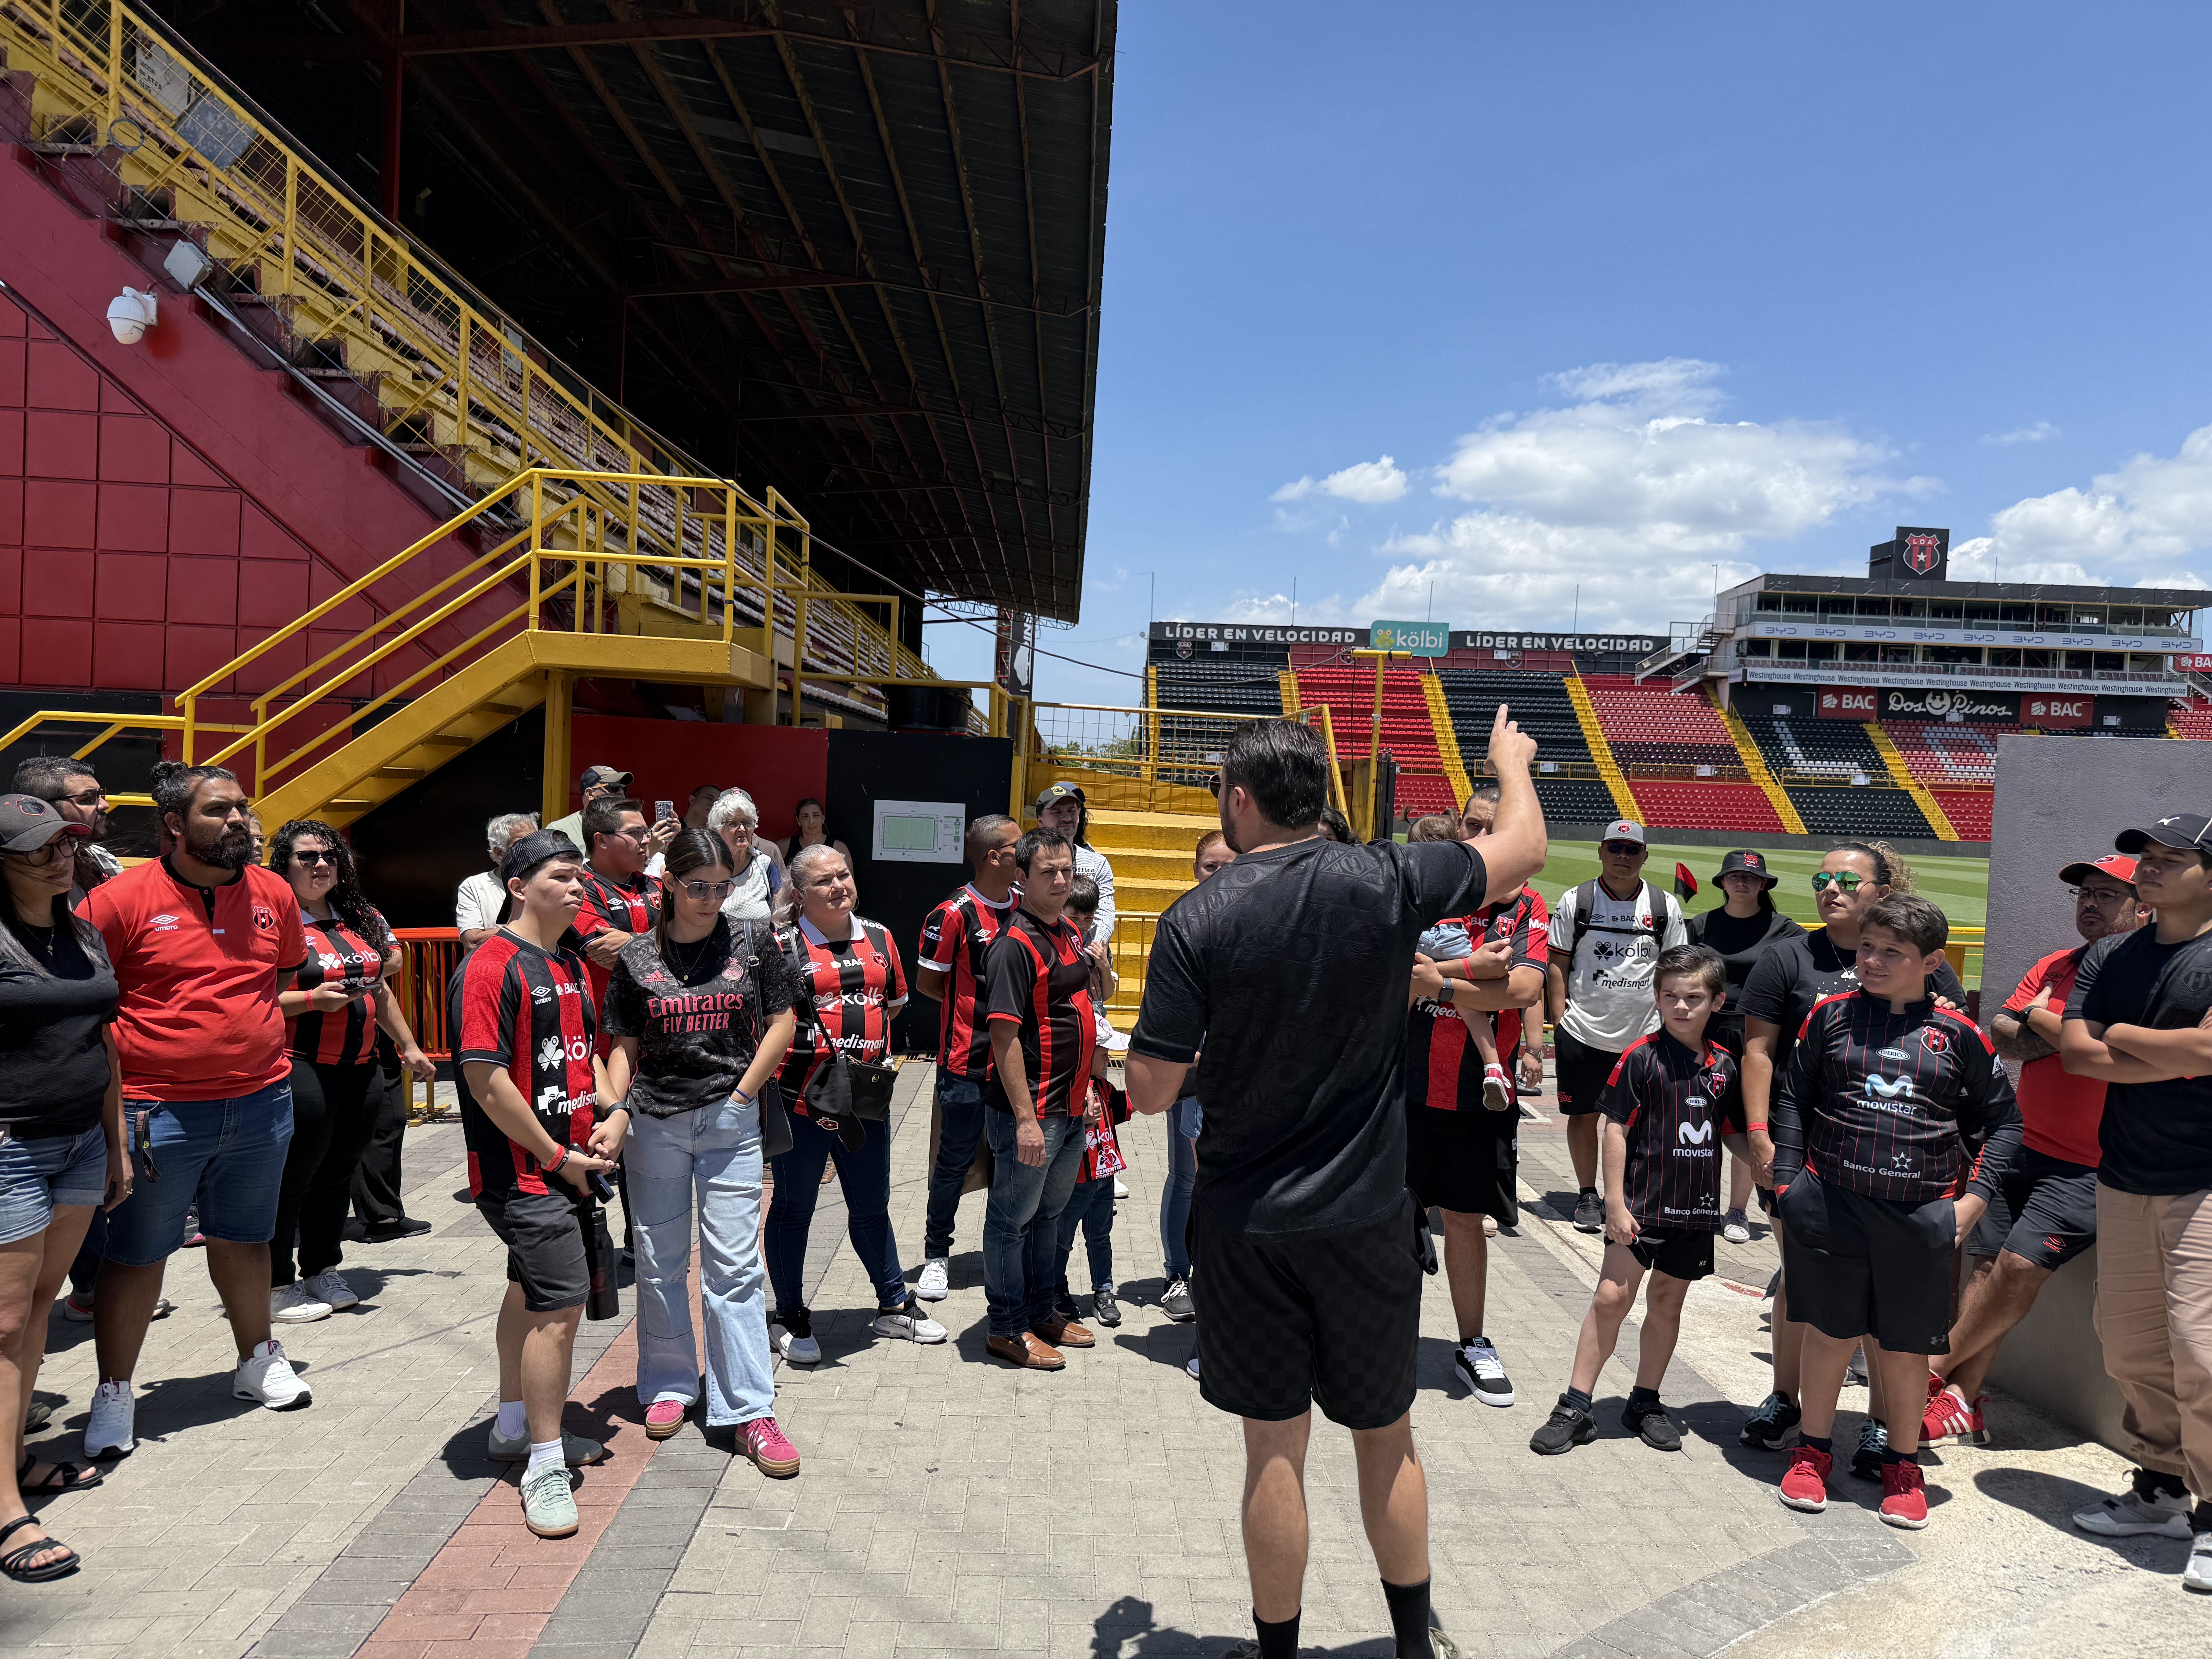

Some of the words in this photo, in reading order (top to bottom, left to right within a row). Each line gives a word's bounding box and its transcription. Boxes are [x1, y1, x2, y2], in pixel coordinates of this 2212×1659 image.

[1165, 624, 1218, 639] LÍDER
[1224, 629, 1247, 640] EN
[1252, 630, 1355, 643] VELOCIDAD
[1396, 629, 1443, 648] kölbi
[1865, 630, 1895, 638] BYD
[1467, 632, 1517, 648] LÍDER
[1522, 636, 1545, 649] EN
[1551, 637, 1654, 651] VELOCIDAD
[2195, 657, 2212, 668] BA
[1749, 672, 1791, 680] Westinghouse
[1793, 673, 1835, 682] Westinghouse
[1838, 674, 1879, 684] Westinghouse
[1882, 676, 1923, 686] Westinghouse
[1926, 678, 1967, 687] Westinghouse
[1970, 680, 2011, 689] Westinghouse
[2014, 681, 2055, 690] Westinghouse
[2058, 682, 2099, 692] Westinghouse
[2102, 684, 2142, 693] Westinghouse
[2145, 686, 2186, 695] Westinghouse
[1842, 695, 1874, 710] BAC
[1889, 692, 1926, 713] Dos
[1949, 694, 2012, 716] Pinos
[2051, 702, 2082, 717] BAC
[843, 958, 866, 967] BAC
[804, 968, 821, 976] umbro
[1602, 977, 1650, 989] medismart
[648, 991, 744, 1018] Emirates
[664, 1016, 683, 1034] FLY
[686, 1012, 730, 1032] BETTER
[1857, 1100, 1917, 1115] movistar
[1673, 1148, 1714, 1157] movistar
[1843, 1160, 1875, 1173] Banco
[1879, 1168, 1920, 1178] General
[1664, 1207, 1690, 1215] Banco
